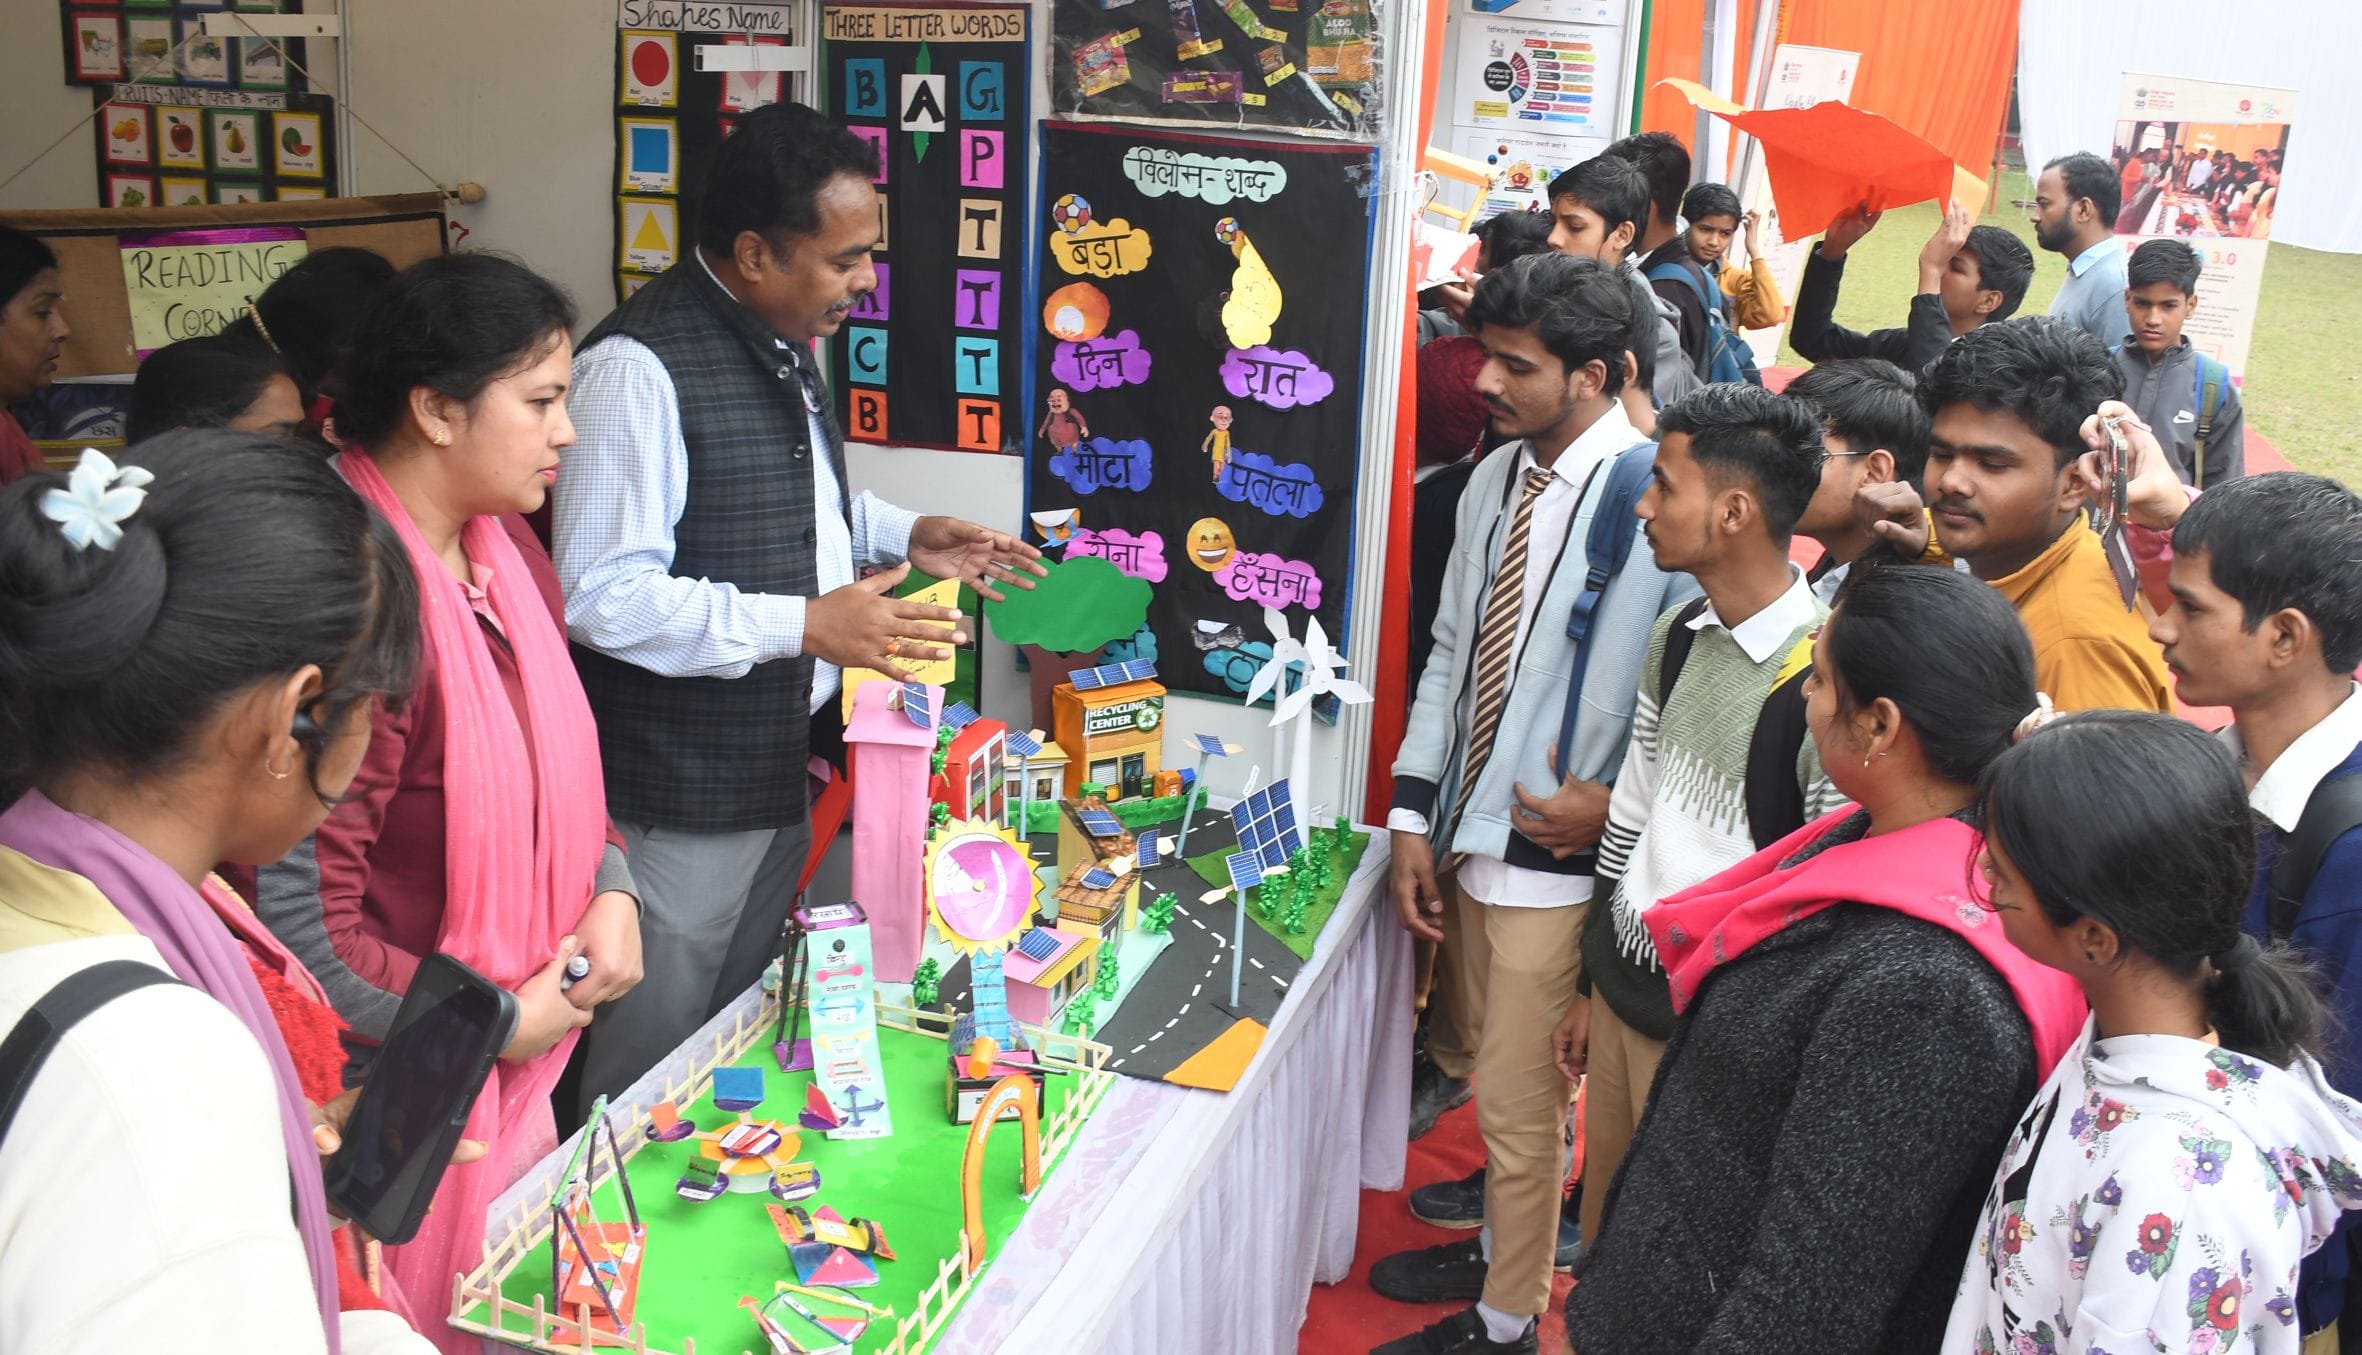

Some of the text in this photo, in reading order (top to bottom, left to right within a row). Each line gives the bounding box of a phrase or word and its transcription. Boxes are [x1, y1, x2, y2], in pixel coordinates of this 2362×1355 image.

[624, 0, 784, 31] Shapes Name
[826, 10, 1021, 38] THREE LETTER WORDS
[1325, 19, 1353, 28] ALOO
[855, 67, 1000, 124] B A G
[969, 135, 994, 181] P
[965, 207, 997, 251] T
[131, 245, 289, 289] READING
[1067, 233, 1132, 276] बड़ा
[2212, 251, 2236, 266] 3.0
[961, 279, 995, 325] T
[855, 336, 991, 386] C T
[1073, 342, 1128, 382] दिन
[1237, 358, 1307, 397] रात
[858, 395, 993, 443] B T
[1075, 442, 1136, 485] मोटा
[1228, 461, 1312, 509] पतला
[1089, 700, 1147, 718] RECYCLING
[1089, 714, 1132, 730] CENTER
